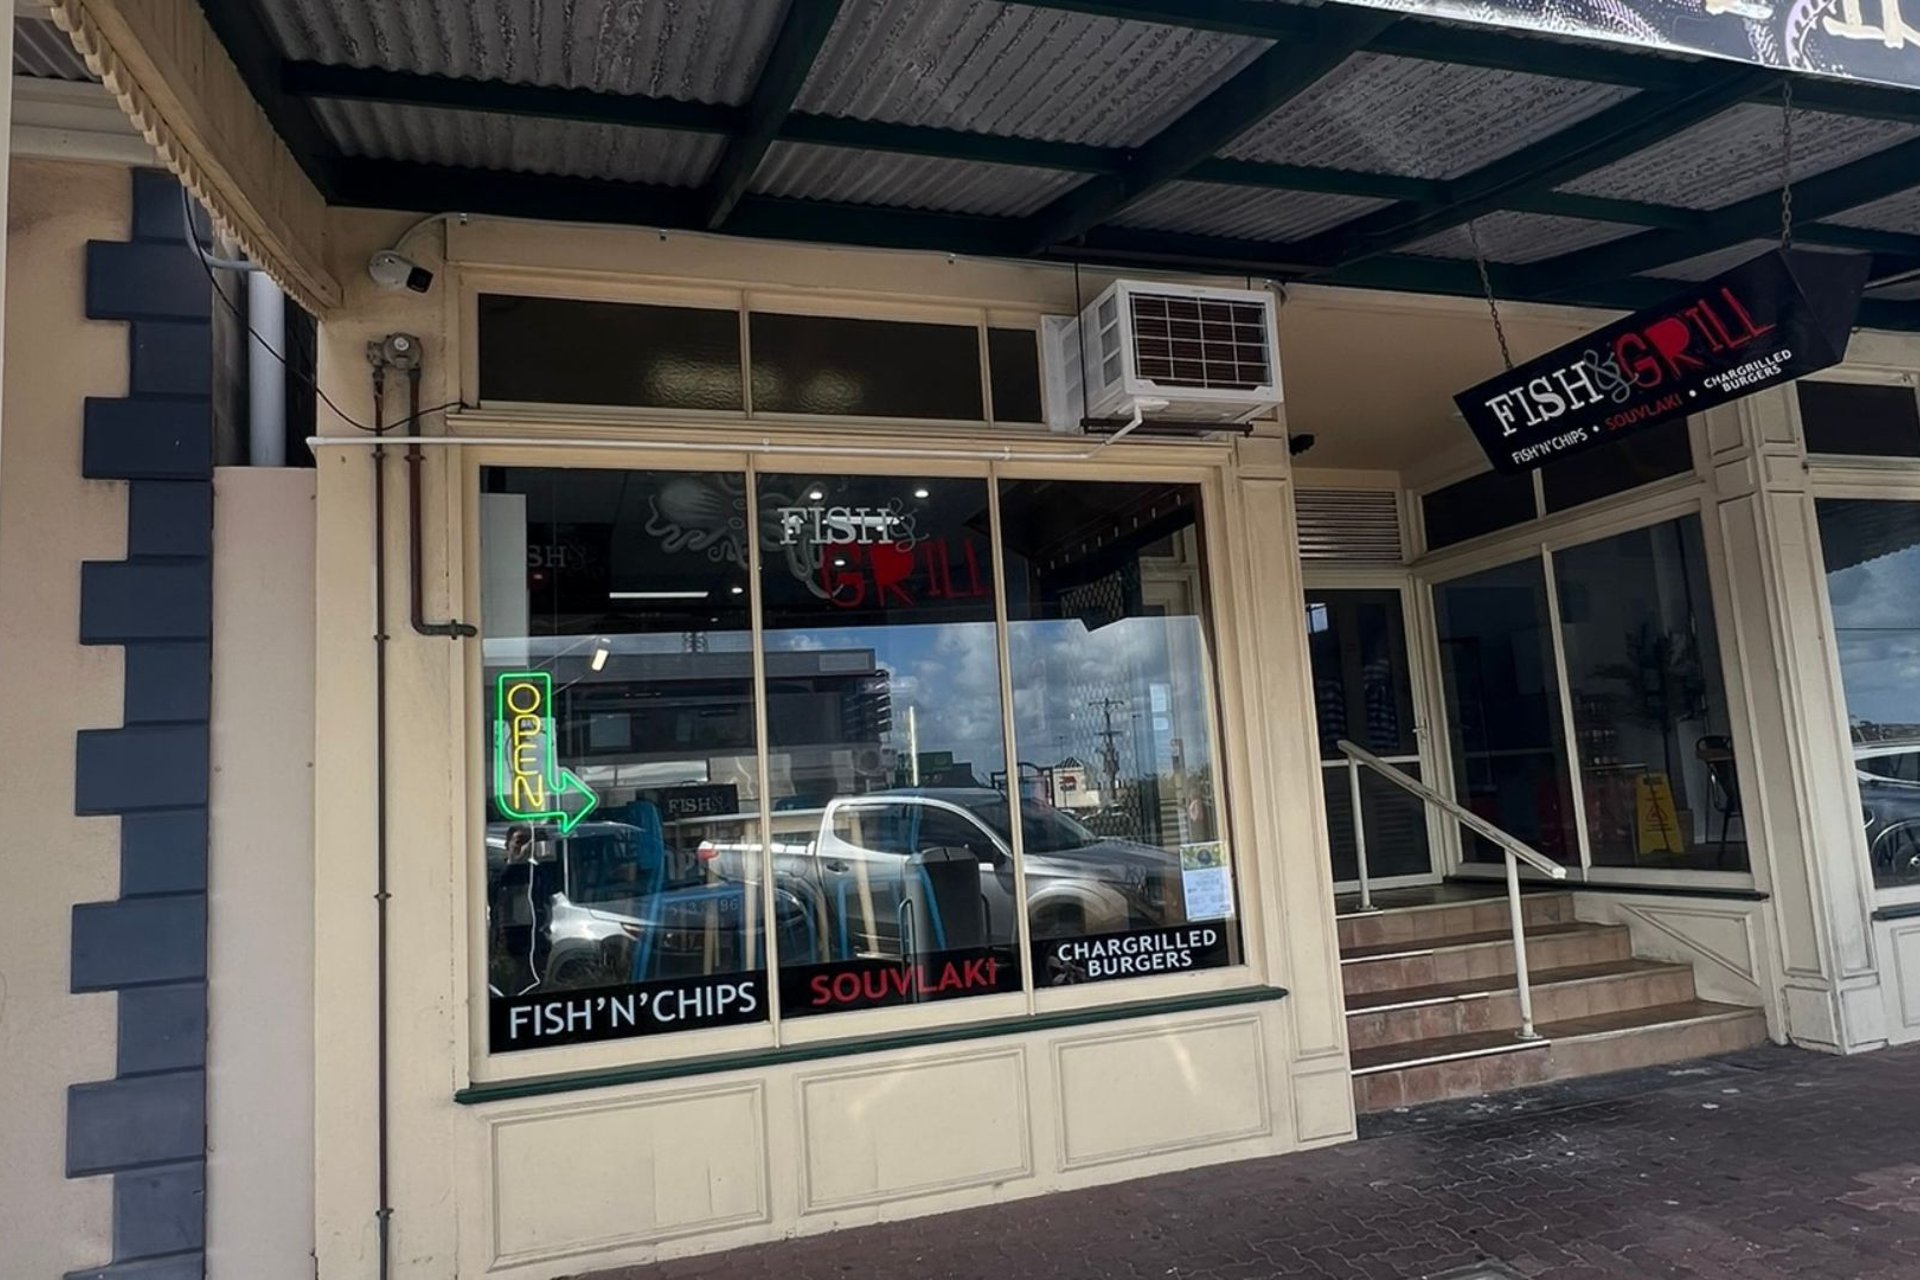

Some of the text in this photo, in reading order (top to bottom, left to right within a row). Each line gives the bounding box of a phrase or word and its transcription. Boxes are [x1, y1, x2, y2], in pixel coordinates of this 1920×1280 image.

[1485, 360, 1604, 437] FISH
[1615, 287, 1777, 389] GRILL
[1703, 349, 1792, 389] CHARGRILLED
[1722, 364, 1782, 392] BURGERS
[1605, 393, 1683, 431] SOUVLAKI
[777, 506, 895, 545] FISH
[820, 535, 993, 610] GRILL
[507, 682, 544, 810] OPEN
[1058, 929, 1217, 961] CHARGRILLED
[1088, 950, 1193, 978] BURGERS
[810, 957, 998, 1006] SOUVLAKI
